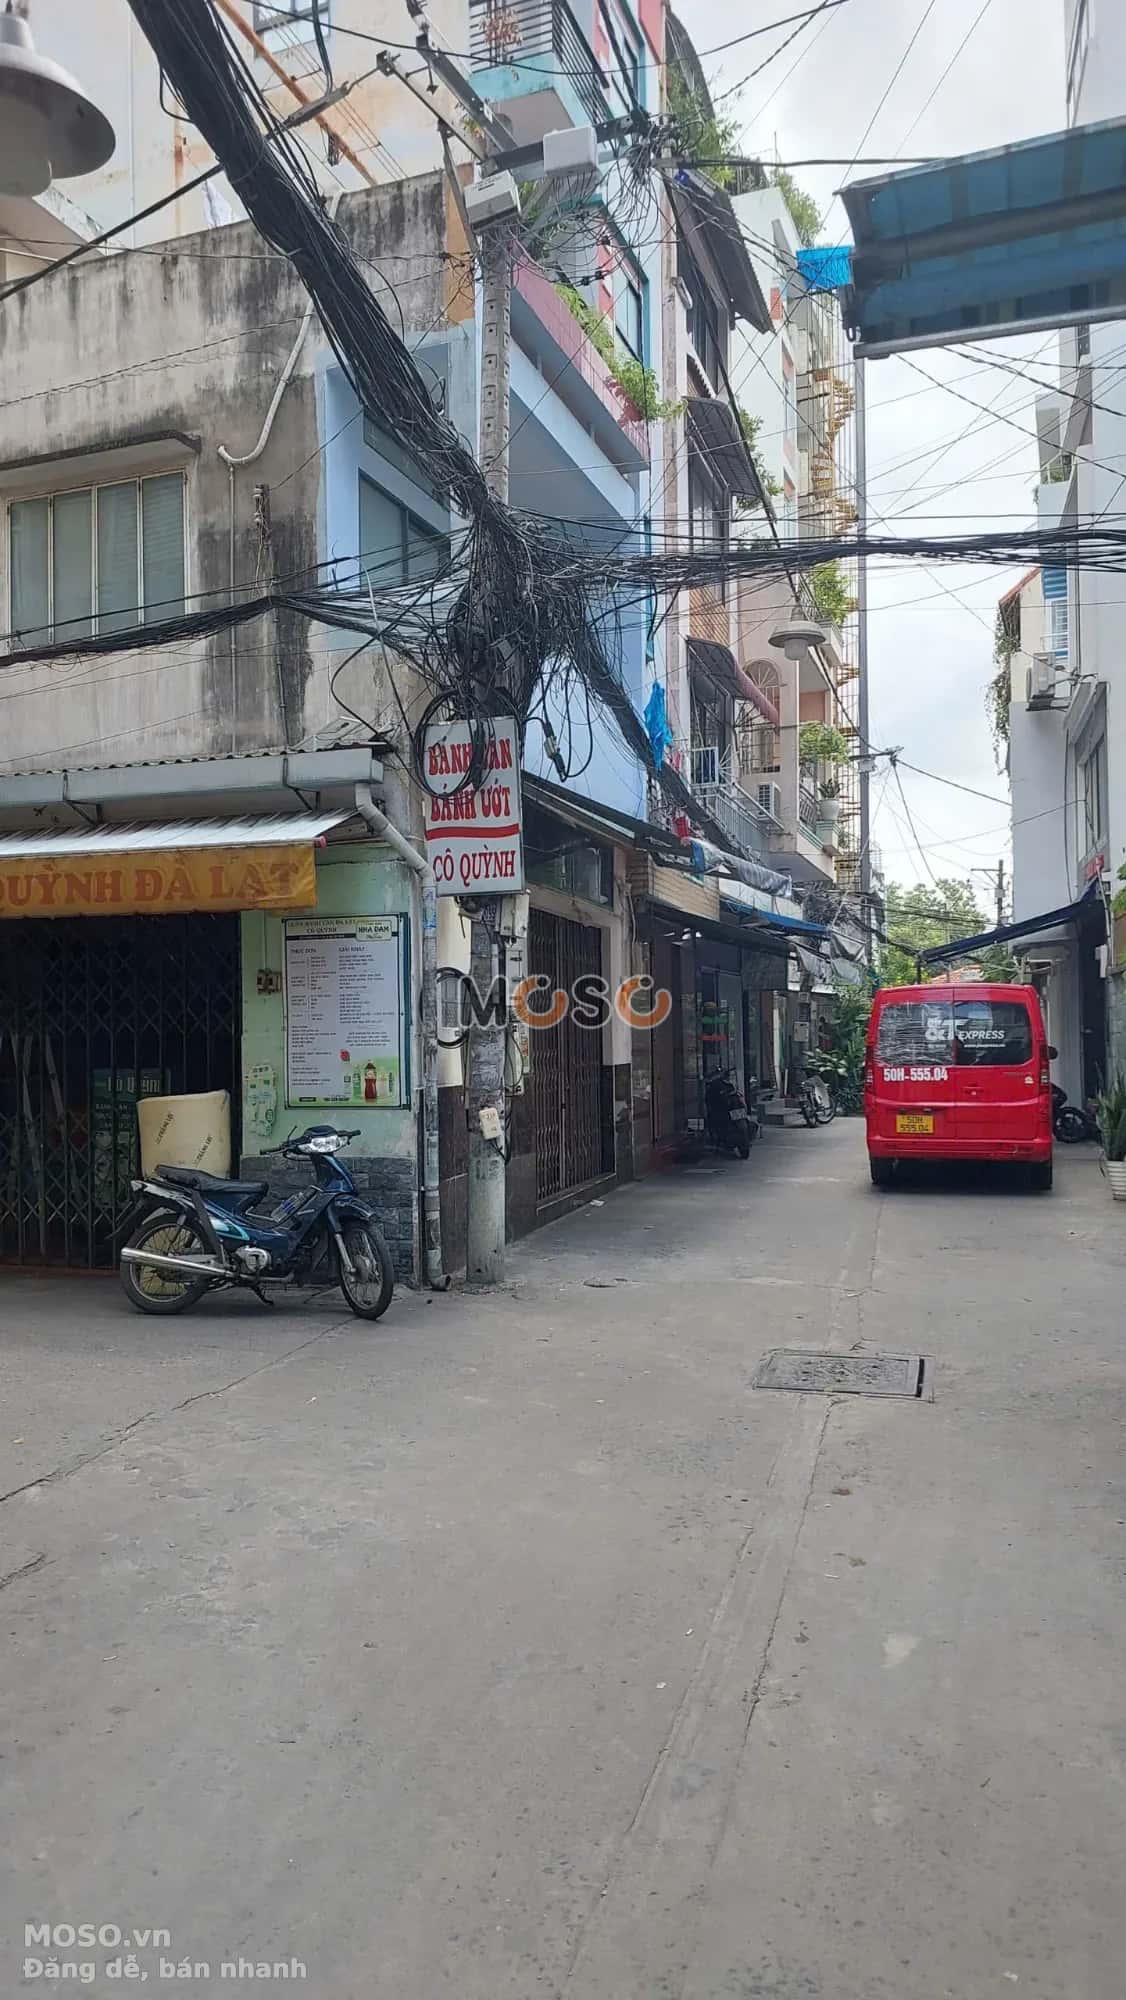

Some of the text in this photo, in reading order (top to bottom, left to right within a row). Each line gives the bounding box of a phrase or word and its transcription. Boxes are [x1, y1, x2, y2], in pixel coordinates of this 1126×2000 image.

[428, 736, 472, 775] BÁNH
[430, 777, 510, 822] BÁNH ƯỚT
[135, 855, 193, 901] ĐÀ
[433, 844, 516, 887] CÔ QUỲNH
[959, 1029, 1006, 1040] EXPRESS
[883, 1067, 949, 1081] 50H-555.04
